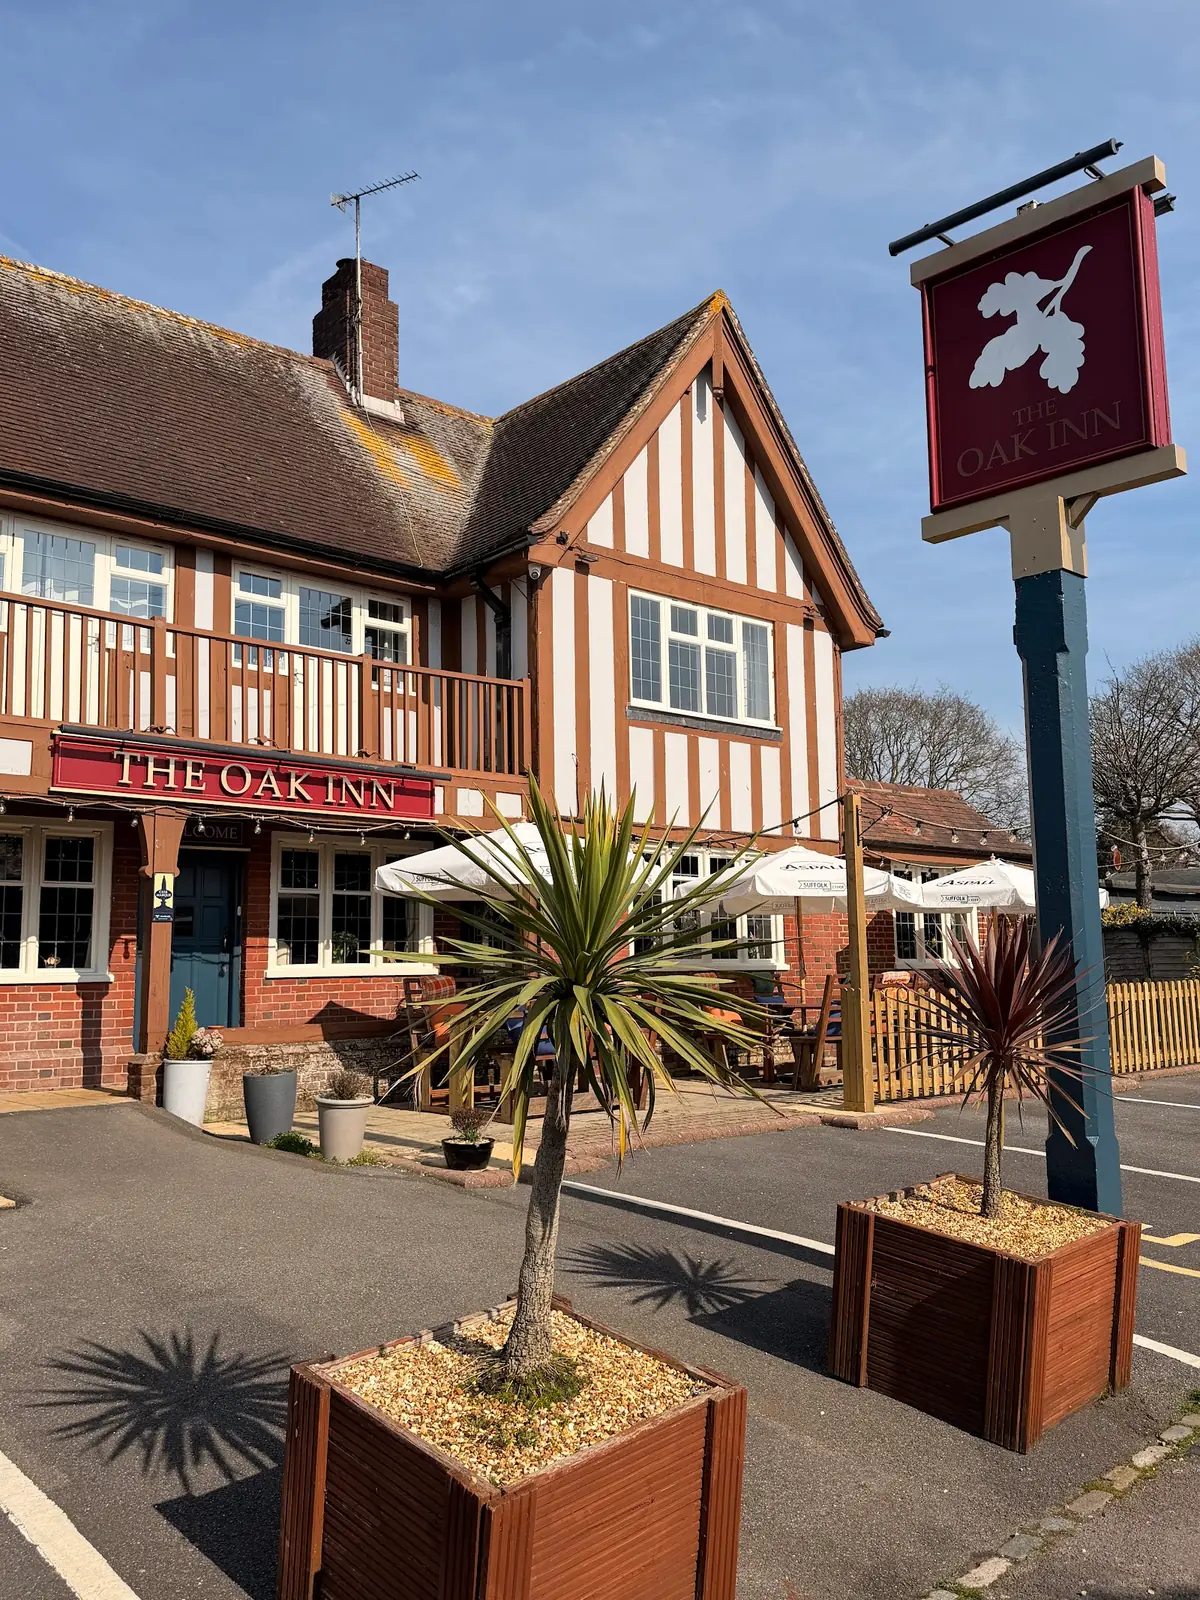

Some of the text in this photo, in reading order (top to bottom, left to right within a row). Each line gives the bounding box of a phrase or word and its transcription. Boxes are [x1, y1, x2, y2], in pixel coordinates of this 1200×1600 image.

[1012, 398, 1058, 427] THE
[957, 400, 1121, 477] OAK INN
[113, 750, 397, 809] THE OAK INN
[184, 825, 238, 839] LCOME
